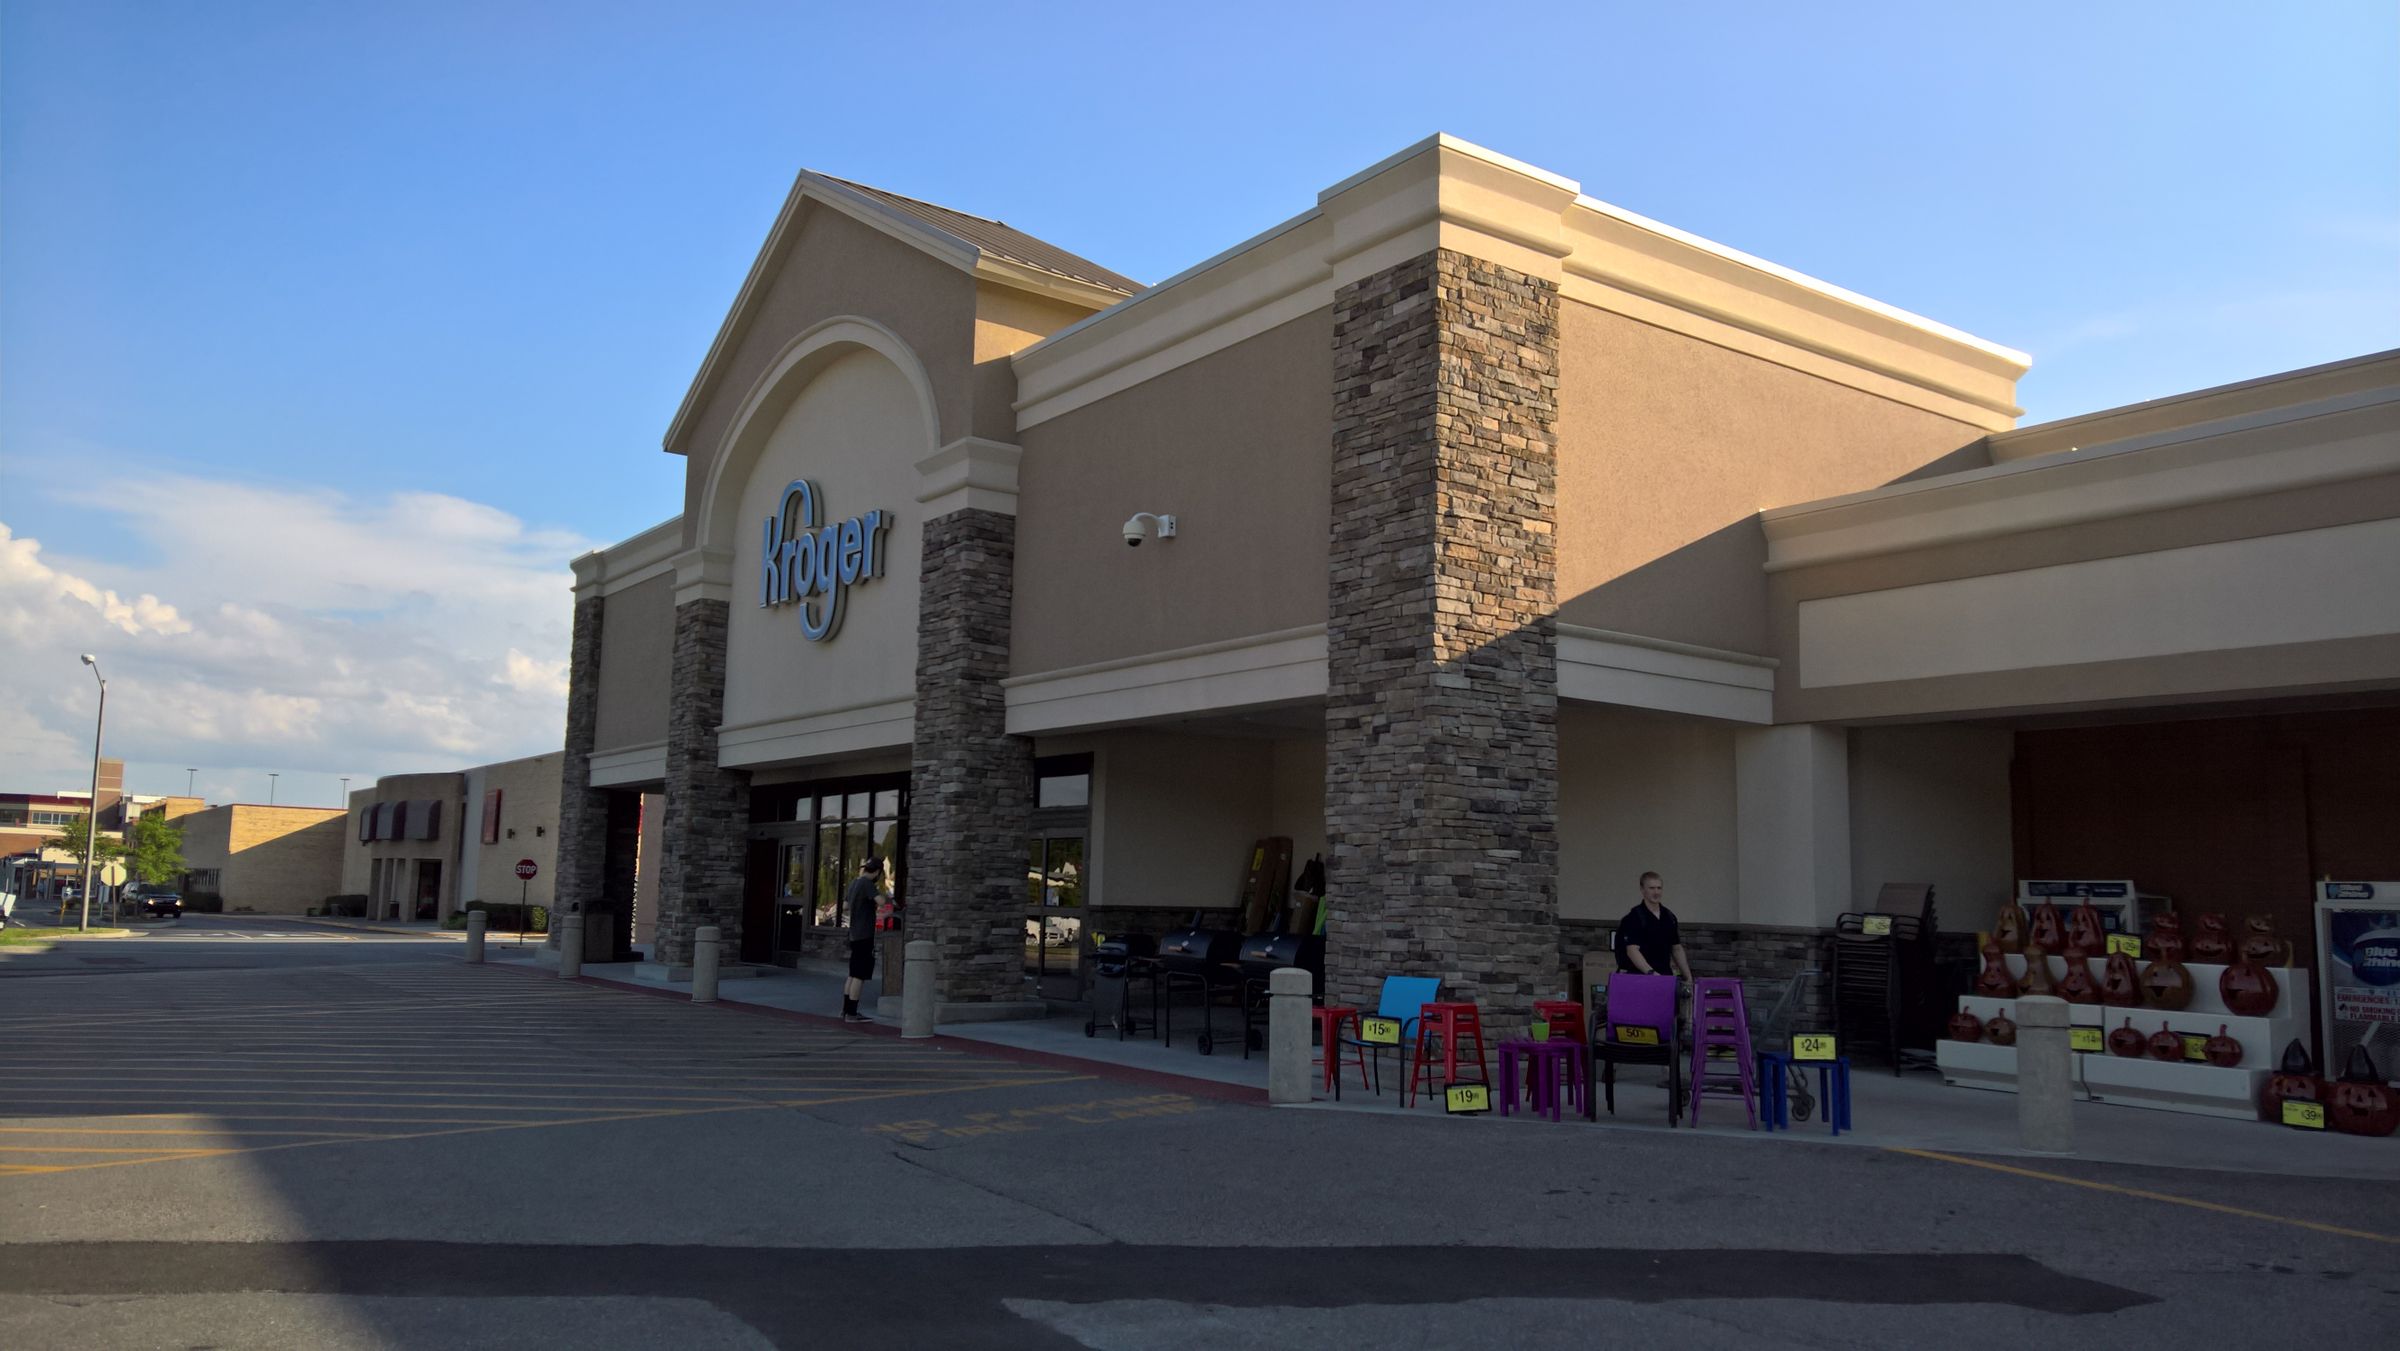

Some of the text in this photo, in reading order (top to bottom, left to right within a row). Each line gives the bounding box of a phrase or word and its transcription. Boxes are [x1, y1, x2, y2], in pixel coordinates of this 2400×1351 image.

[760, 479, 885, 641] Kroger
[516, 865, 537, 874] STOP
[2365, 946, 2398, 957] Blue
